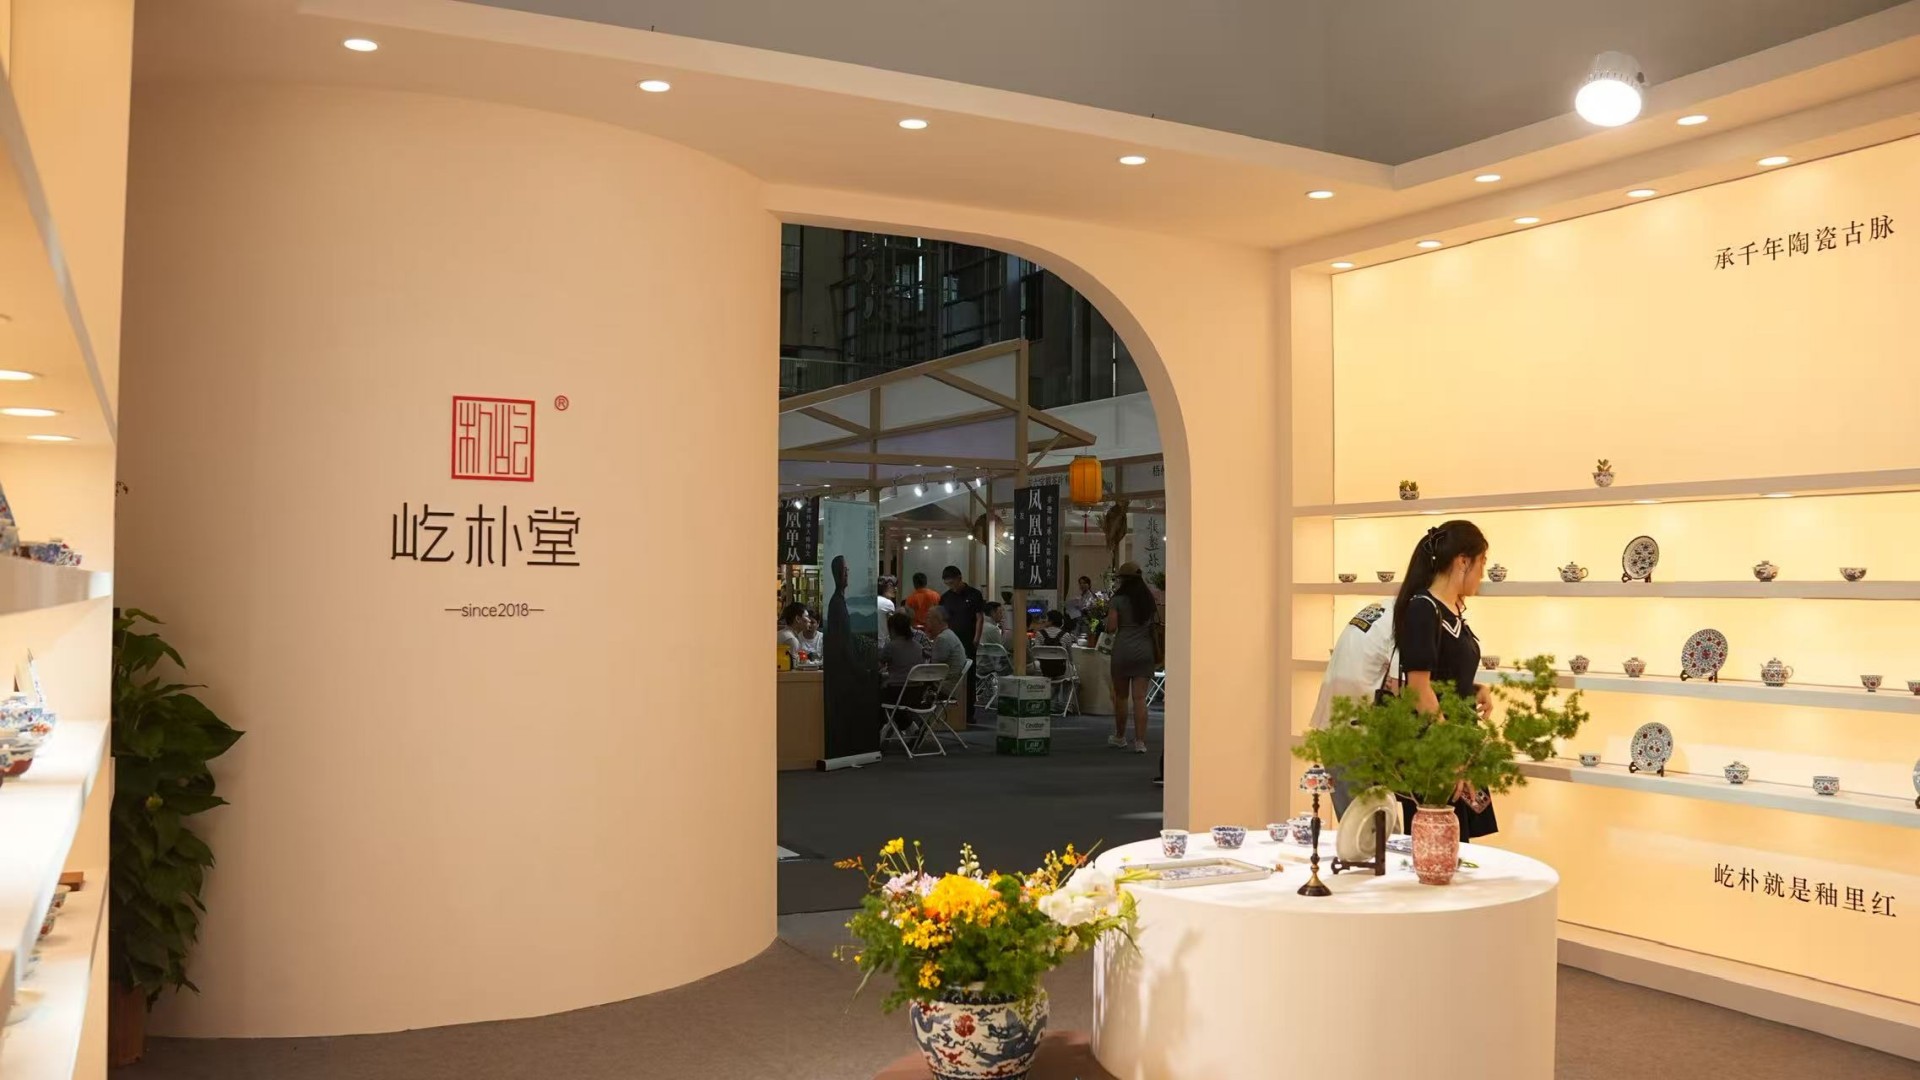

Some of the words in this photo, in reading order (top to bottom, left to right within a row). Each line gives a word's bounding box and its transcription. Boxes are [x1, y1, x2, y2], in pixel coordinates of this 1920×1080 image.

[1714, 215, 1895, 270] 承千年陶瓷古脉
[391, 502, 580, 567] 屹朴堂
[461, 603, 530, 617] since2018
[1714, 863, 1897, 918] 屹朴就是釉里红
